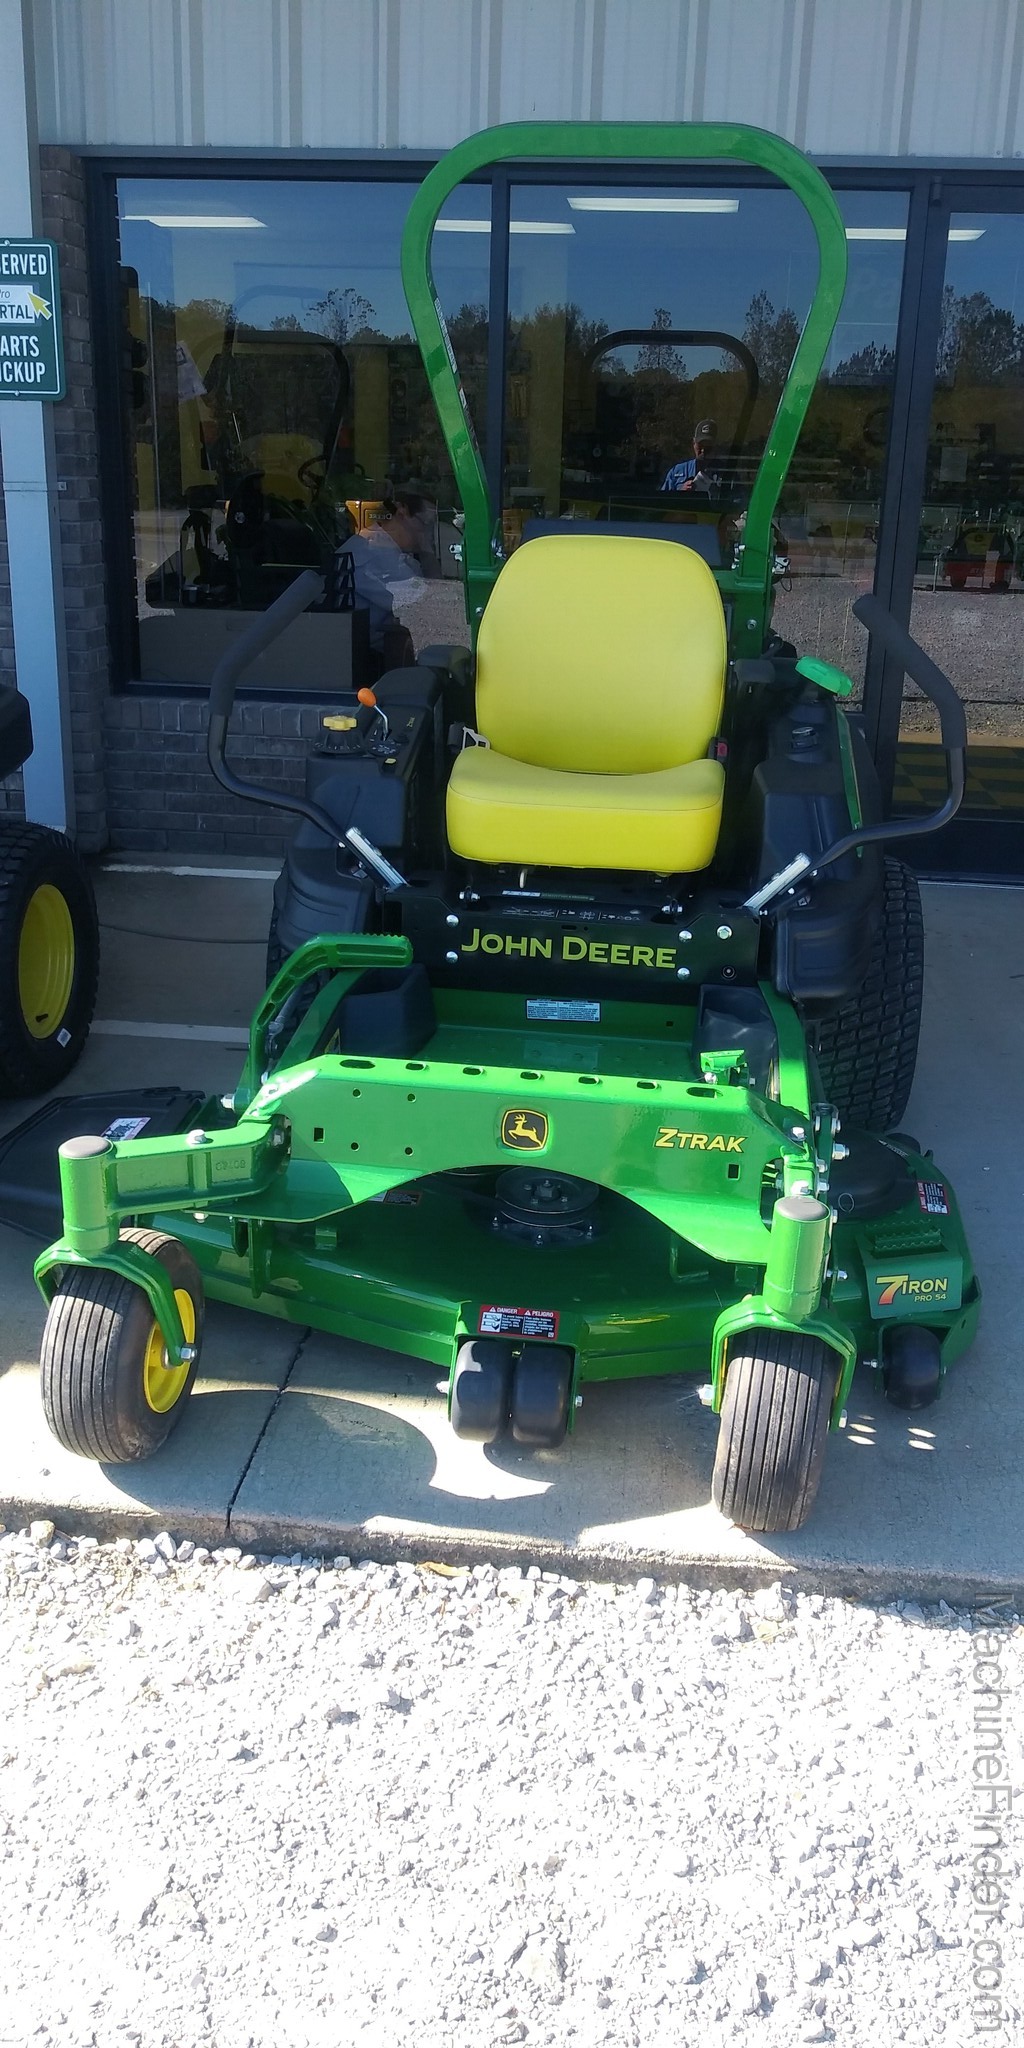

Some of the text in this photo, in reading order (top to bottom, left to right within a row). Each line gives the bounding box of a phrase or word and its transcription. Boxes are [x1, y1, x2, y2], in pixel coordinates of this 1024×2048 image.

[0, 253, 47, 275] ERVED
[462, 928, 676, 969] JOHN DEERE
[655, 1127, 746, 1153] ZTRAK
[935, 1293, 947, 1301] 54
